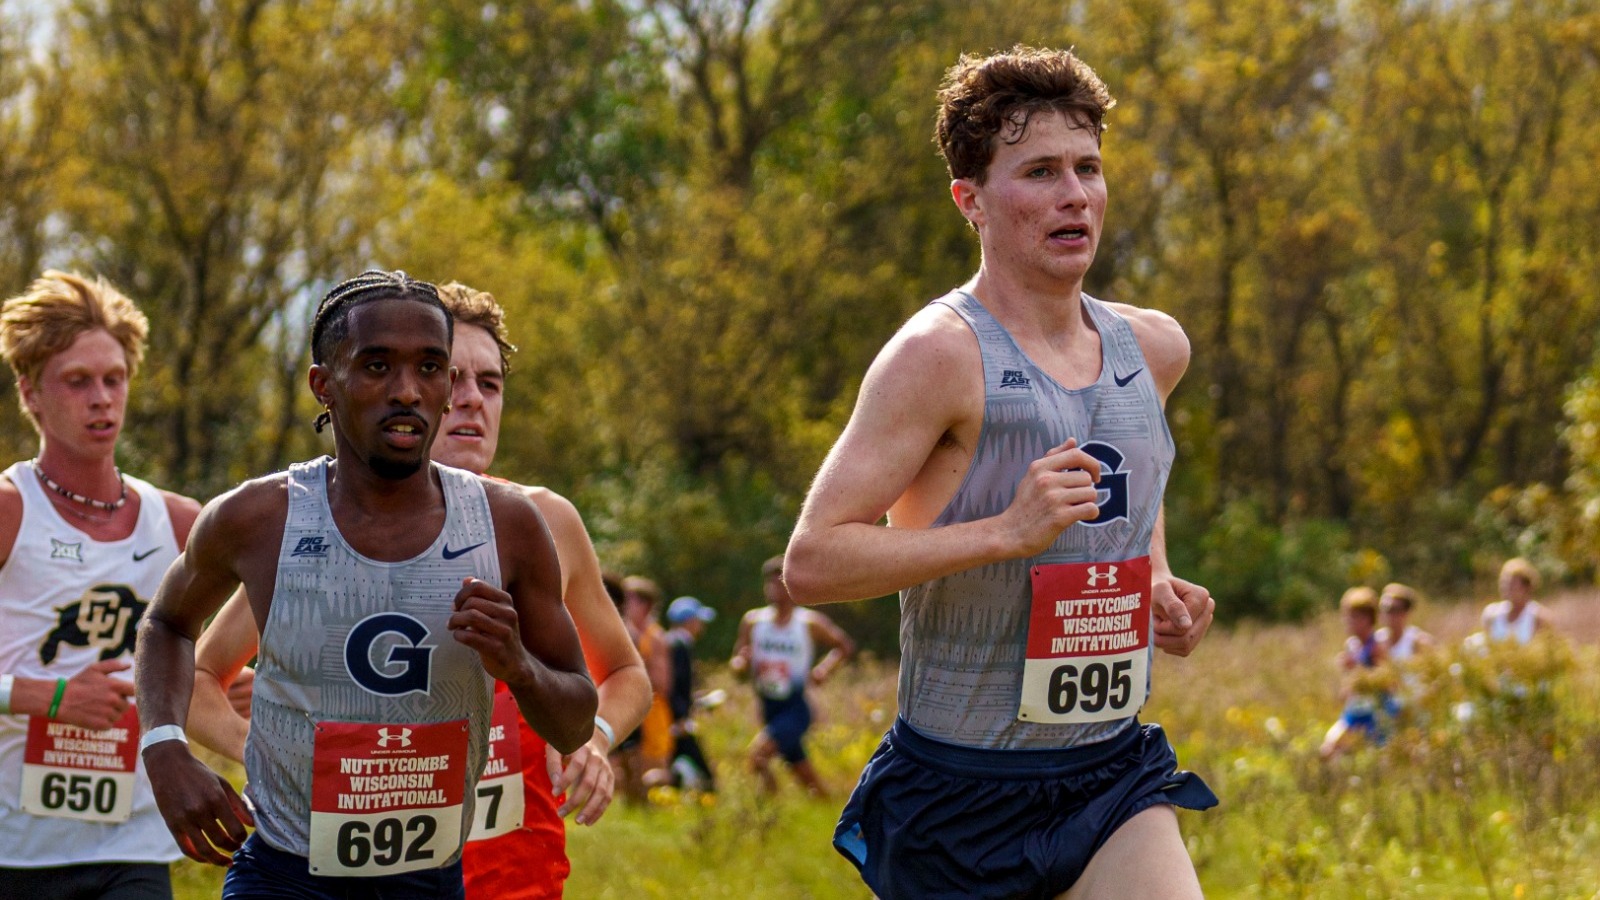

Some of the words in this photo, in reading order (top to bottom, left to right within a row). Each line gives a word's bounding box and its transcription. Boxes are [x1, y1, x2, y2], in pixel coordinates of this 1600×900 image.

[1001, 377, 1030, 385] EAST
[1003, 370, 1023, 378] BIG
[293, 544, 331, 553] EAST
[298, 536, 325, 545] BIG
[1055, 592, 1142, 617] NUTTYCOMBE
[77, 590, 133, 650] CU
[1063, 613, 1132, 635] WISCONSIN
[1051, 630, 1139, 654] INVITATIONAL
[344, 612, 438, 697] G
[1047, 659, 1133, 715] 695
[54, 737, 118, 755] WISCONSIN
[43, 750, 125, 770] INVITATIONAL
[340, 755, 449, 774] NUTTYCOMBE
[41, 772, 117, 814] 650
[350, 774, 434, 792] WISCONSIN
[337, 789, 447, 810] INVITATIONAL
[337, 814, 437, 868] 692
